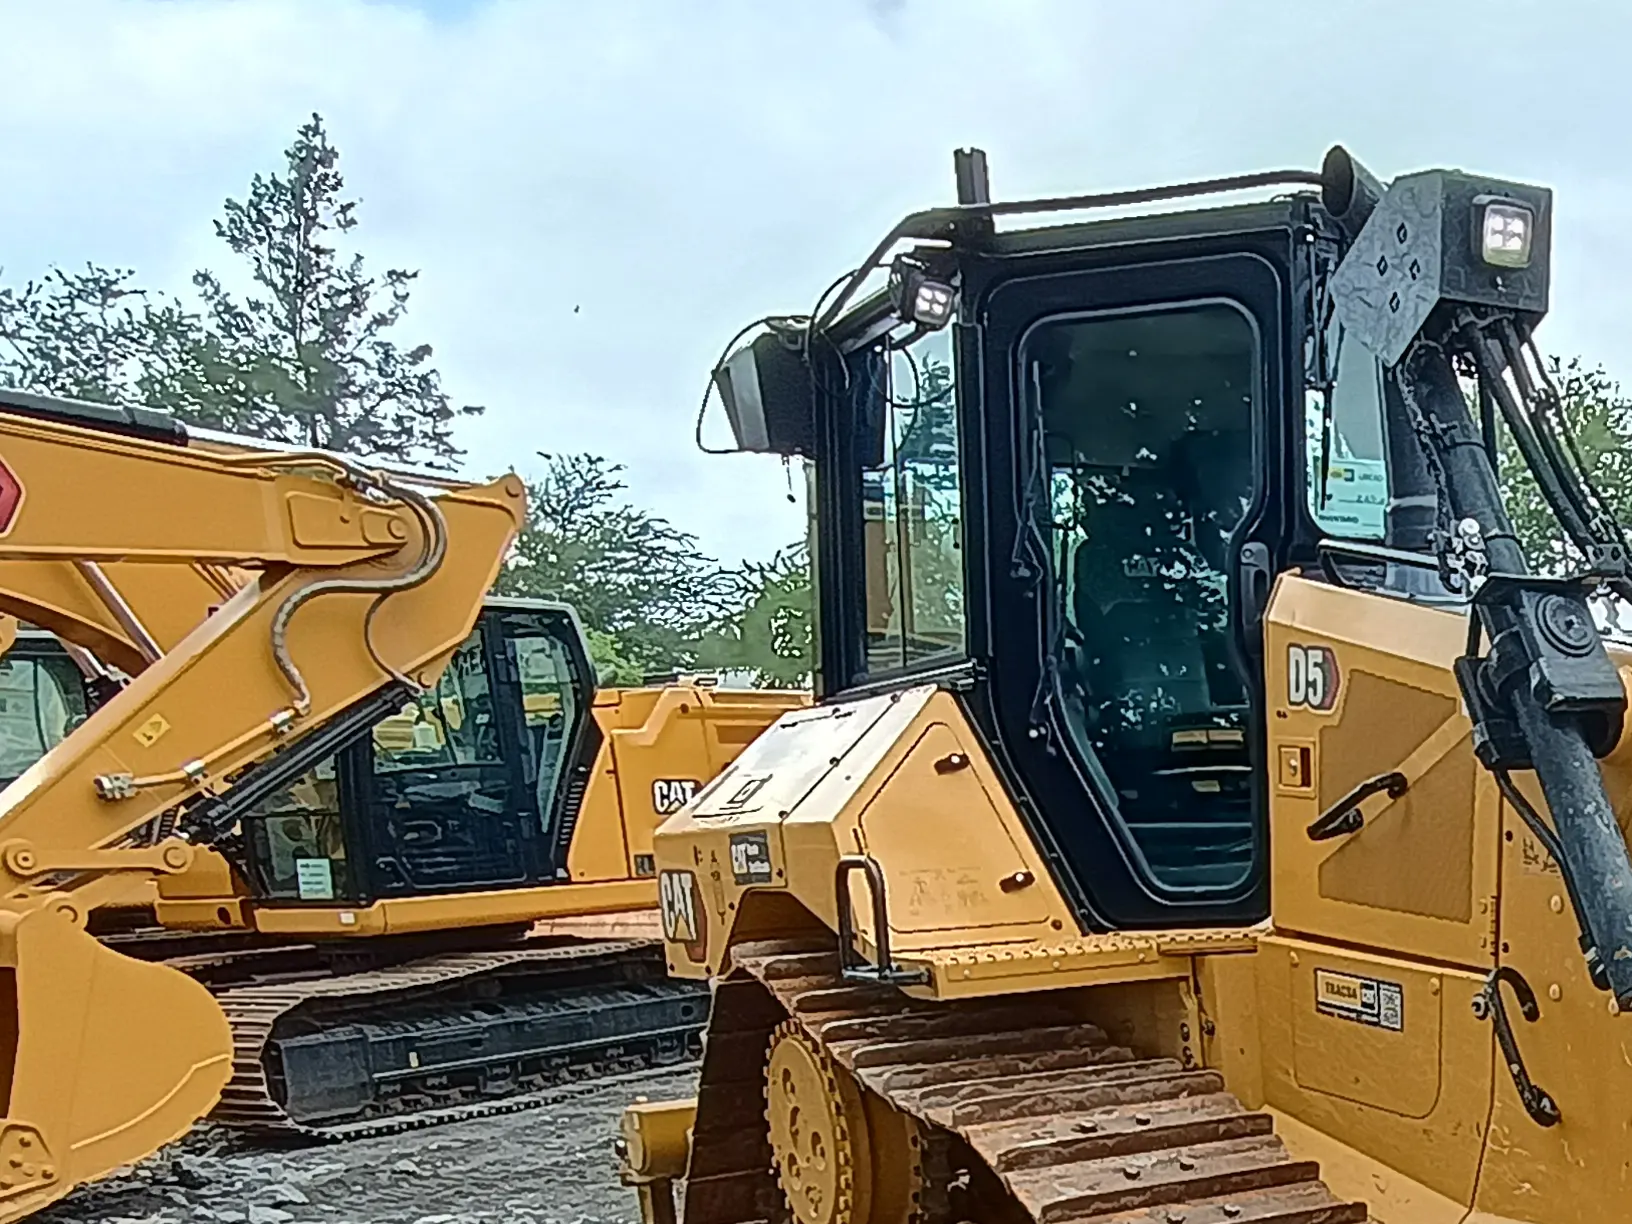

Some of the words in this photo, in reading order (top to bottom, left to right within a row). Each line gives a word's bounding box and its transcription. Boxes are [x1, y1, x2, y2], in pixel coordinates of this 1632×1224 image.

[1289, 647, 1323, 706] D5
[653, 781, 696, 813] CAT
[661, 872, 697, 941] CAT
